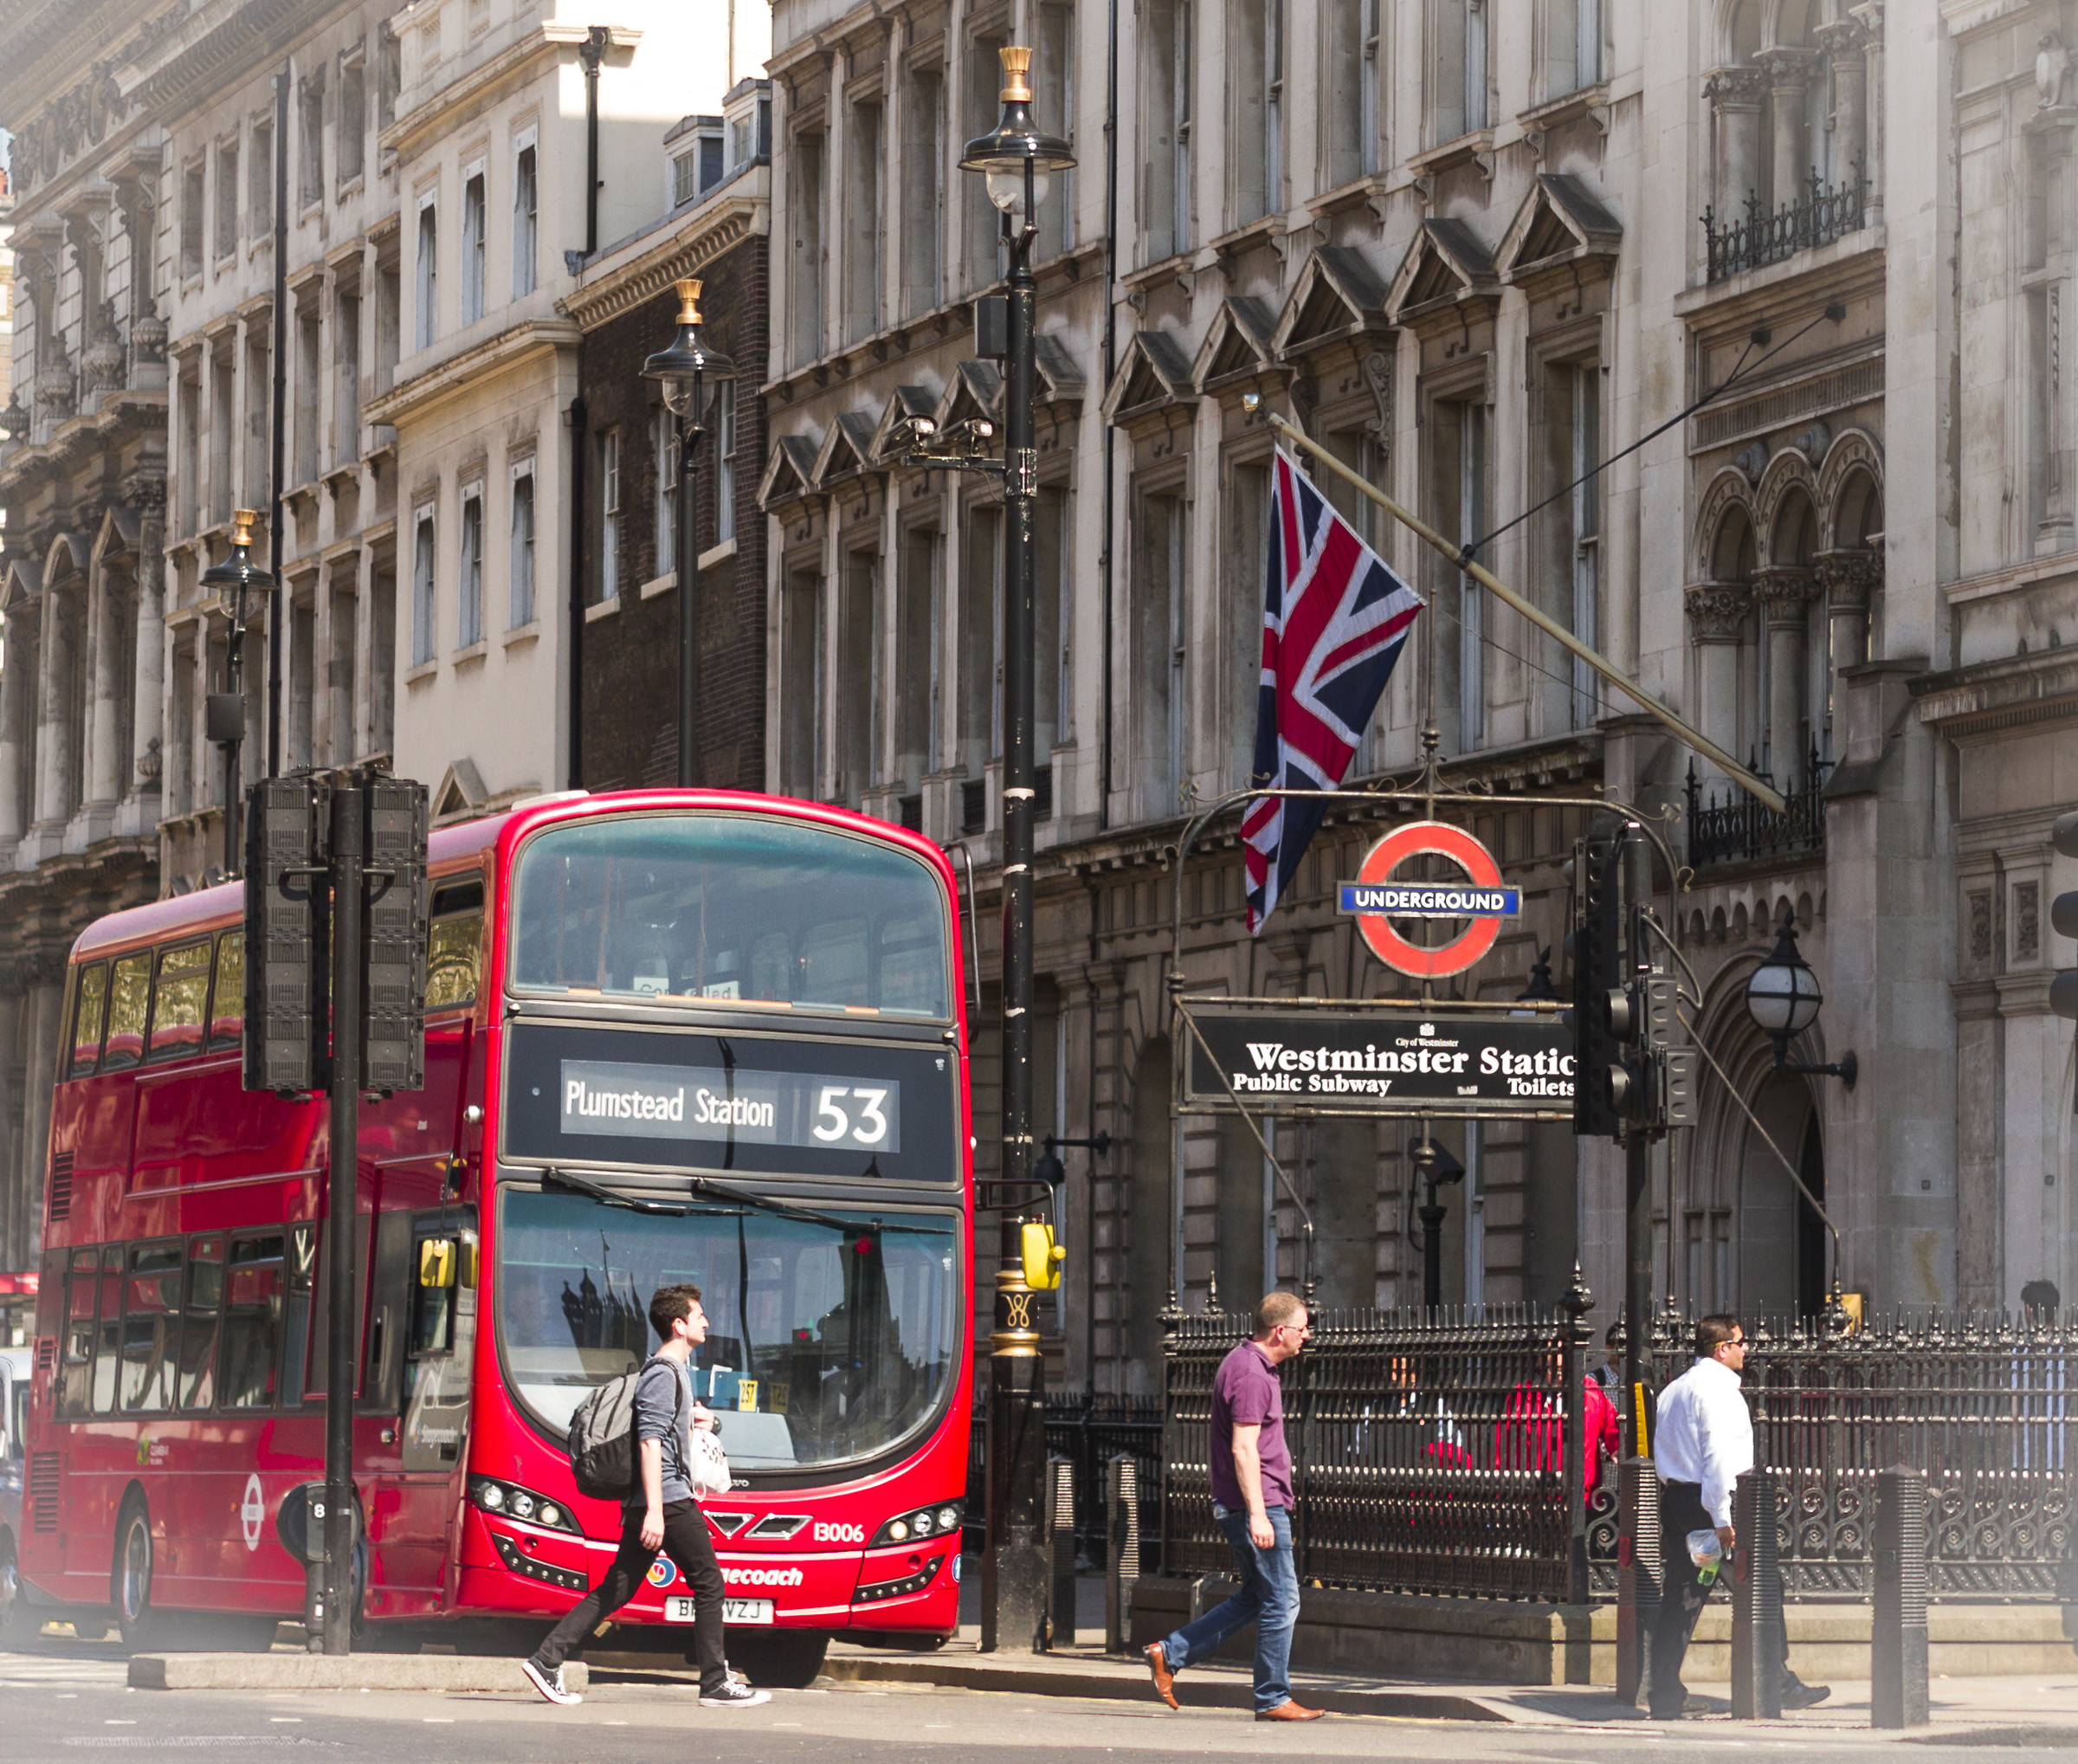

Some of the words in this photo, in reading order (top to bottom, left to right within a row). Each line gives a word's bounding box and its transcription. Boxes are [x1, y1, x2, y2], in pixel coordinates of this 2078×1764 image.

[1355, 890, 1505, 910] UNDERGROUND
[1396, 1038, 1409, 1049] City
[1410, 1038, 1418, 1047] of
[1418, 1038, 1459, 1048] Westminster
[1246, 1043, 1469, 1074] Westminster
[1233, 1073, 1302, 1092] Public
[1308, 1074, 1392, 1098] Subway
[1507, 1076, 1575, 1096] Toilets
[566, 1080, 684, 1121] Plumstead
[694, 1088, 773, 1127] Station
[813, 1086, 887, 1143] 53
[314, 1503, 325, 1518] 8
[814, 1522, 864, 1542] 13006
[720, 1567, 803, 1586] ecoach
[726, 1600, 760, 1619] VZJ
